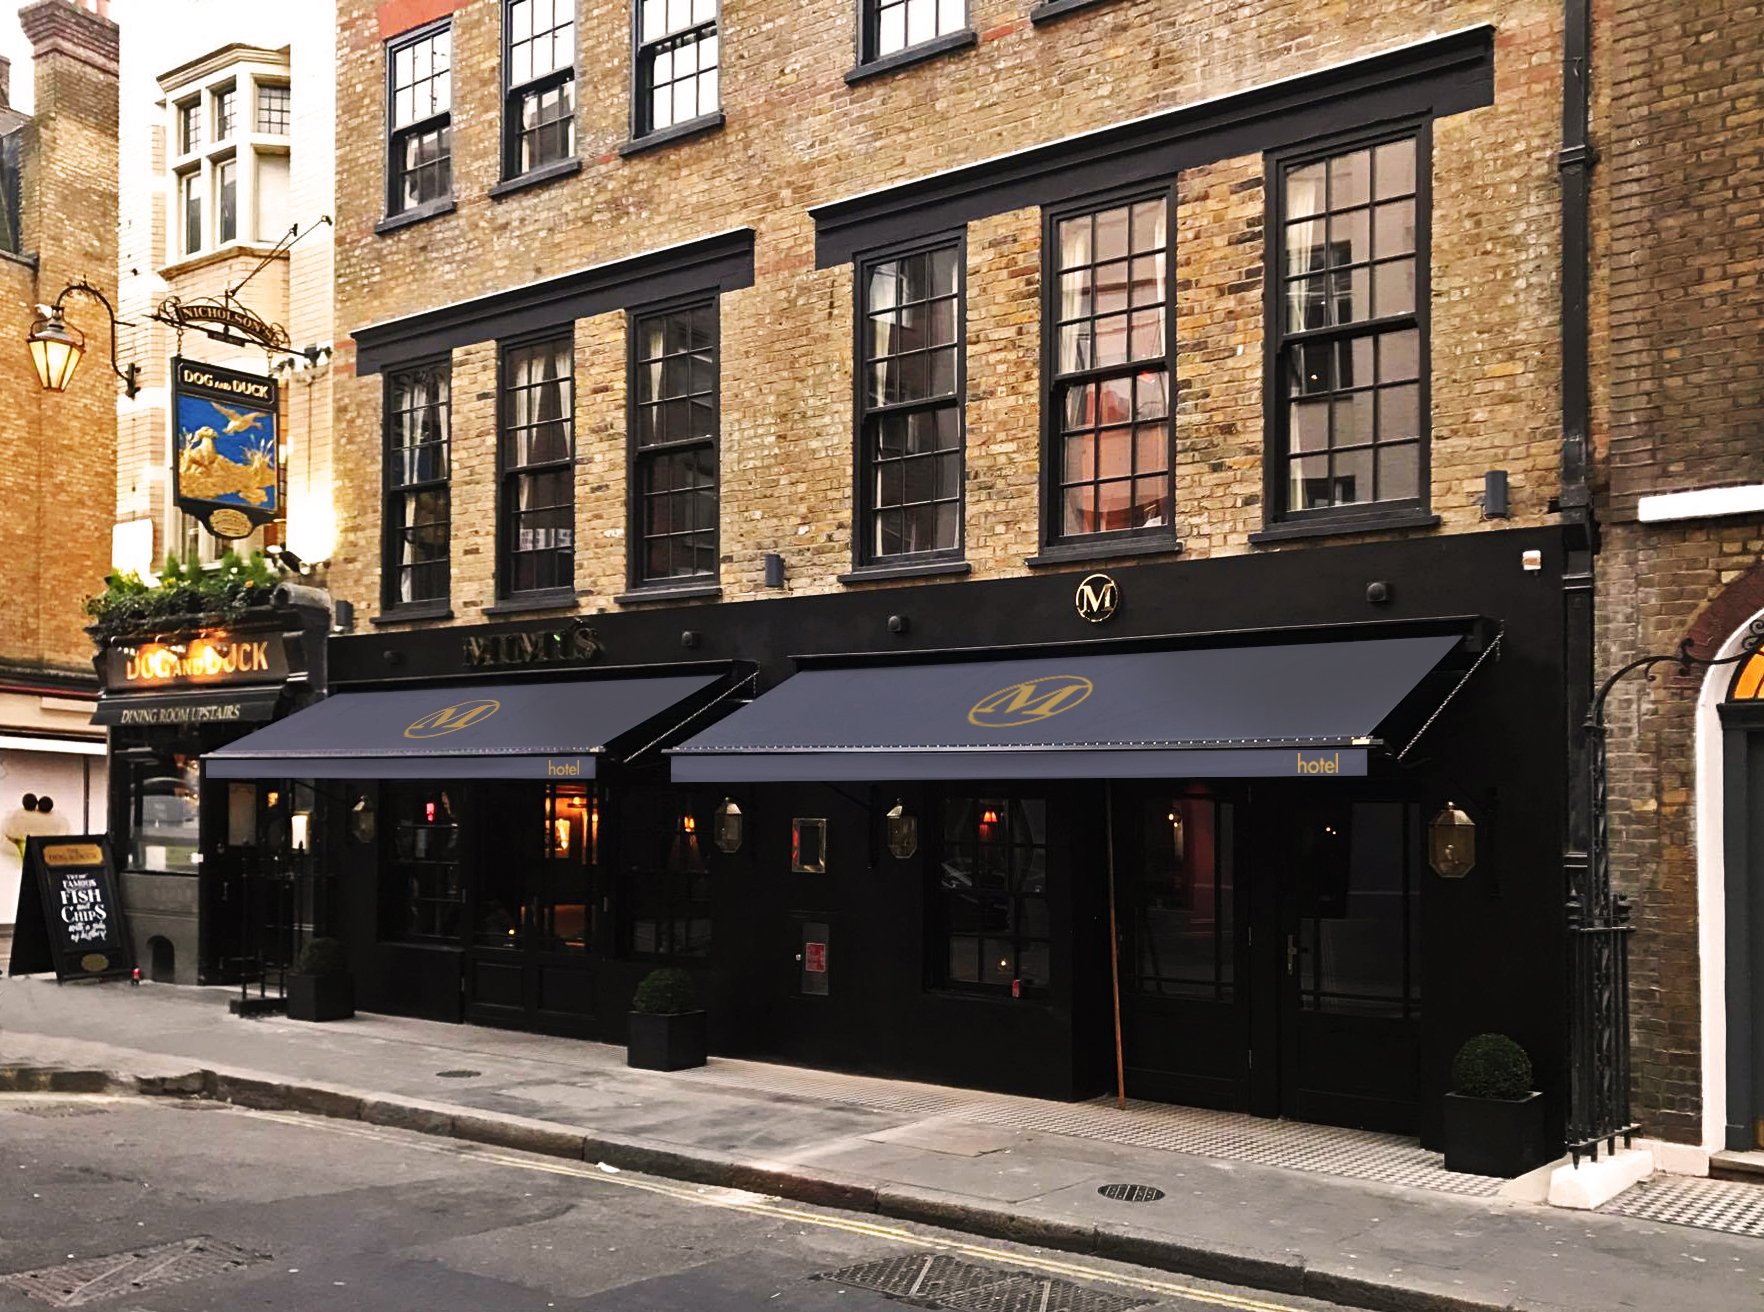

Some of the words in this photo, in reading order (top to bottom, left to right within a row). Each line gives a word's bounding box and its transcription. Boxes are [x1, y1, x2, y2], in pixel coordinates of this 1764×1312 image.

[184, 307, 273, 340] NICHOLSON'S
[184, 370, 213, 387] DOG
[233, 380, 268, 398] DUCK
[172, 657, 203, 676] AND
[203, 641, 268, 675] DUCK
[121, 708, 159, 724] DINING
[159, 706, 190, 723] ROOM
[190, 704, 241, 721] UPSTAIRS
[548, 759, 580, 776] hotel
[1297, 752, 1339, 774] hotel
[62, 879, 97, 889] FAMOUS
[60, 888, 101, 904] FISH
[61, 904, 107, 923] CHIPS
